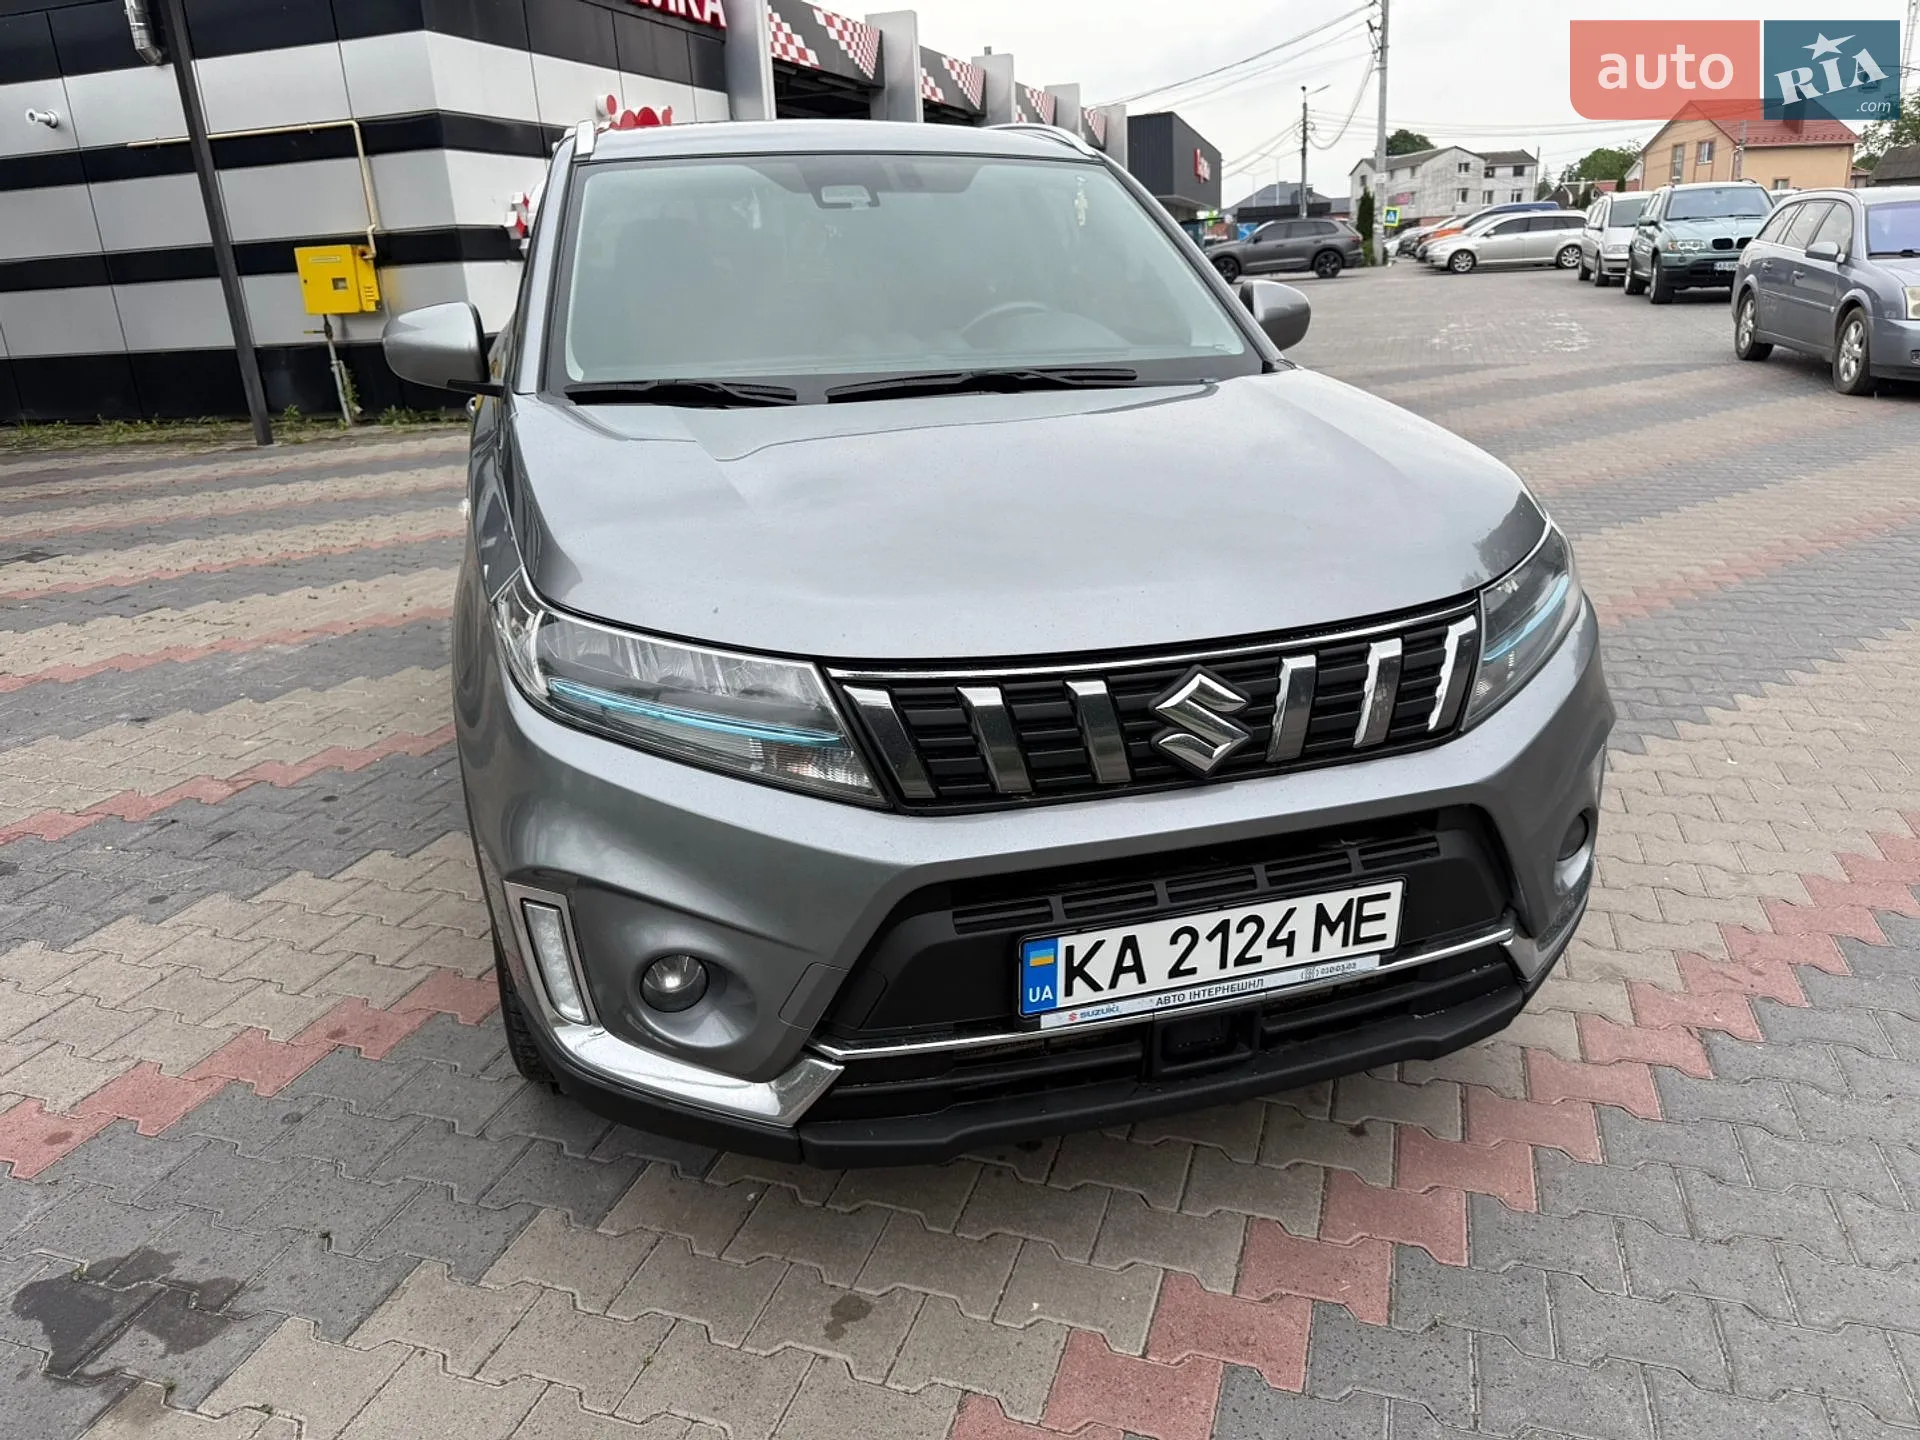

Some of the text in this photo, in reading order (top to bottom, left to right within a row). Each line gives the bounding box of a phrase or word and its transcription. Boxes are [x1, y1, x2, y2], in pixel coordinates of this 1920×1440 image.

[1064, 891, 1392, 998] KA 2124 ME
[1029, 985, 1054, 1003] UA
[1155, 992, 1186, 1007] АВТО
